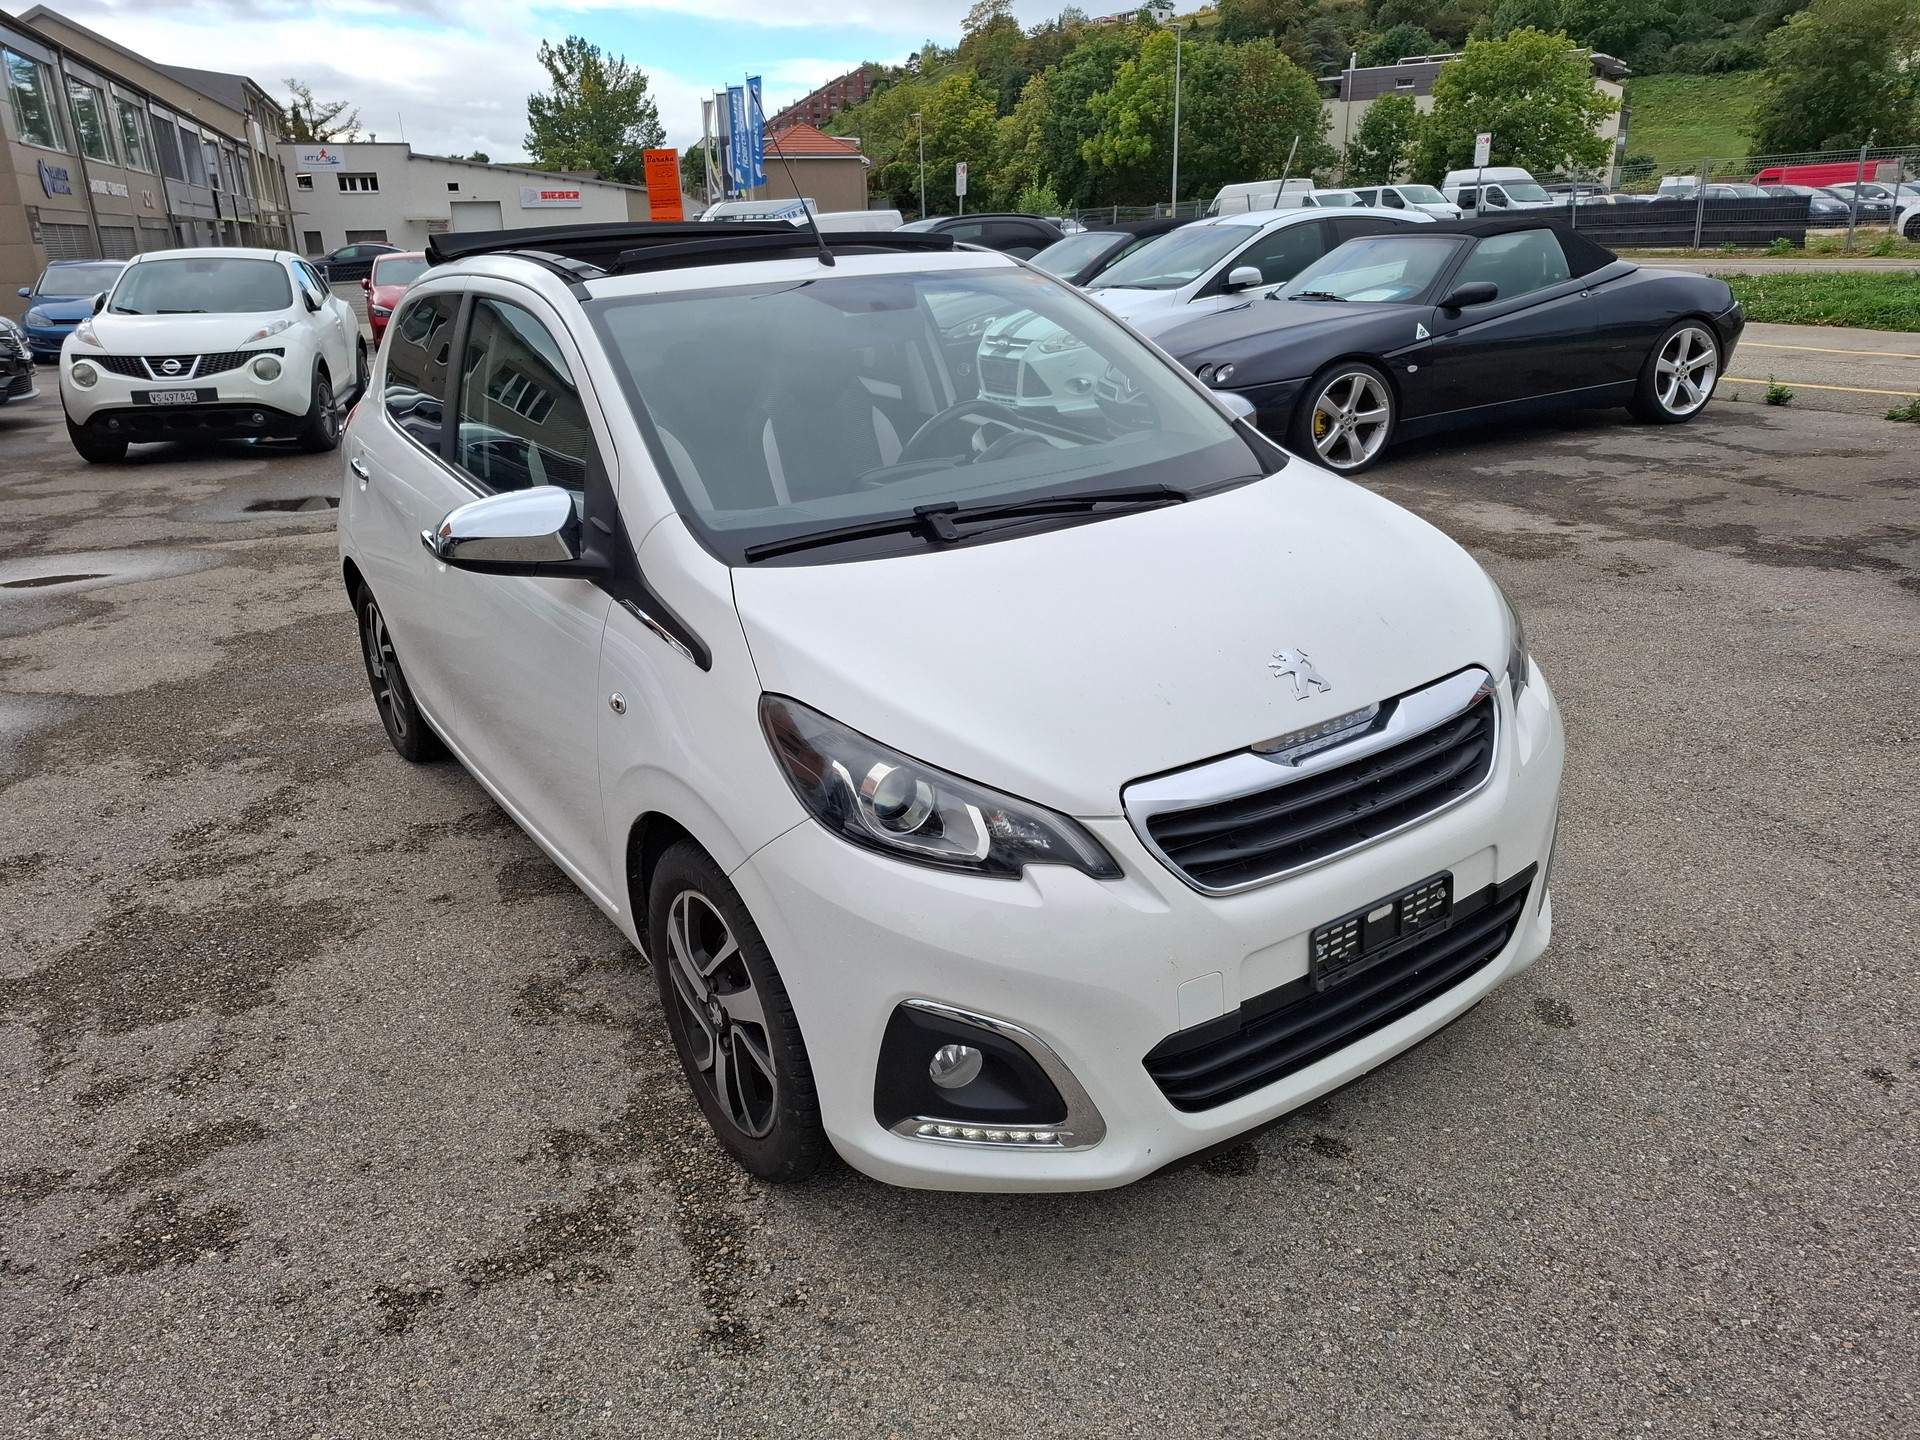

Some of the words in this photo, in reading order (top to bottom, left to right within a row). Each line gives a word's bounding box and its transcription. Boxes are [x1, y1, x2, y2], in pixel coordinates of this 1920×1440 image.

[645, 155, 674, 163] Baraka
[540, 191, 580, 200] SIEBER
[150, 394, 161, 402] VS
[1284, 711, 1363, 747] PEUGEOT
